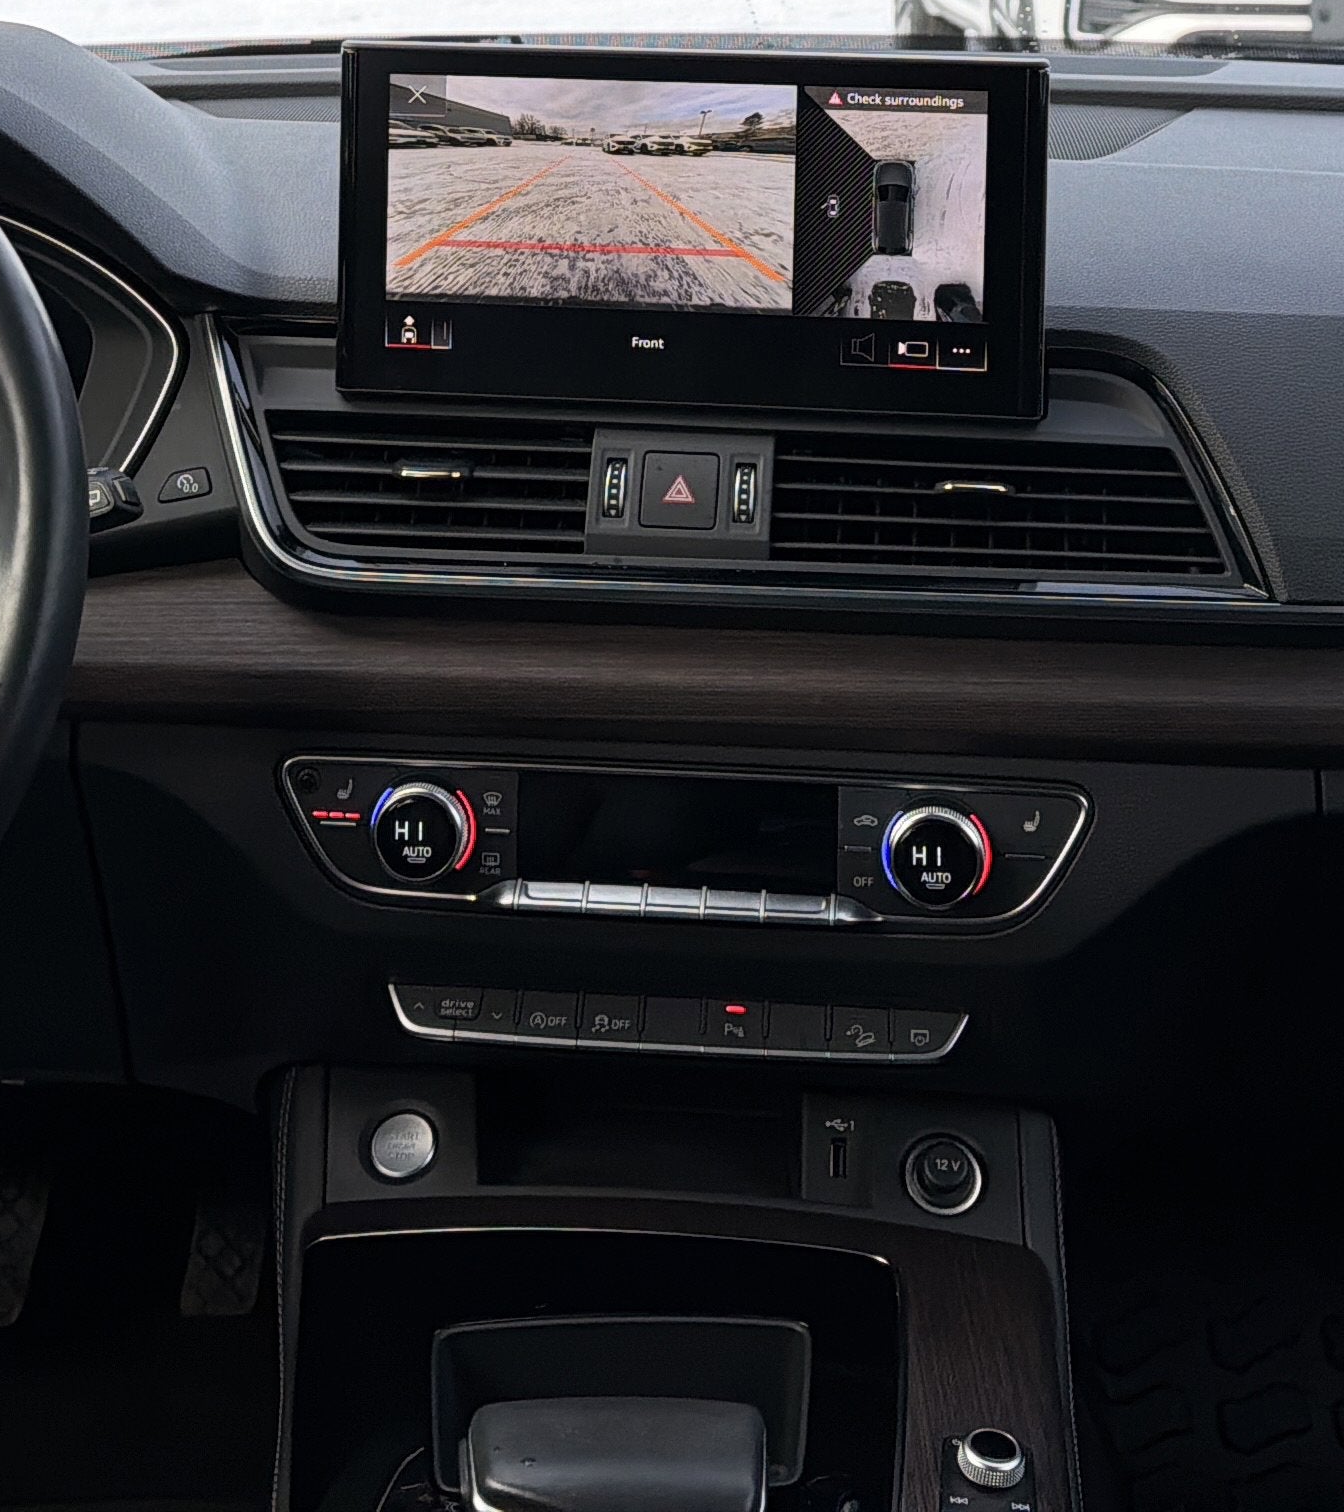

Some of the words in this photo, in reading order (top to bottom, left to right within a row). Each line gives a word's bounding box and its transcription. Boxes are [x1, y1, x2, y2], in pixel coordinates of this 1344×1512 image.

[846, 91, 881, 108] Check
[884, 93, 964, 111] surroundings
[631, 335, 665, 352] Front
[483, 807, 502, 816] MAX
[402, 846, 432, 858] AUTO
[479, 866, 502, 876] REAR
[852, 875, 874, 888] OFF
[920, 872, 952, 884] AUTO
[441, 998, 475, 1009] drive
[440, 1007, 474, 1017] select
[547, 1016, 568, 1028] OFF
[611, 1019, 631, 1031] OFF
[390, 1131, 420, 1141] START
[388, 1151, 416, 1161] STOP
[935, 1158, 948, 1171] 12
[951, 1160, 961, 1172] V
